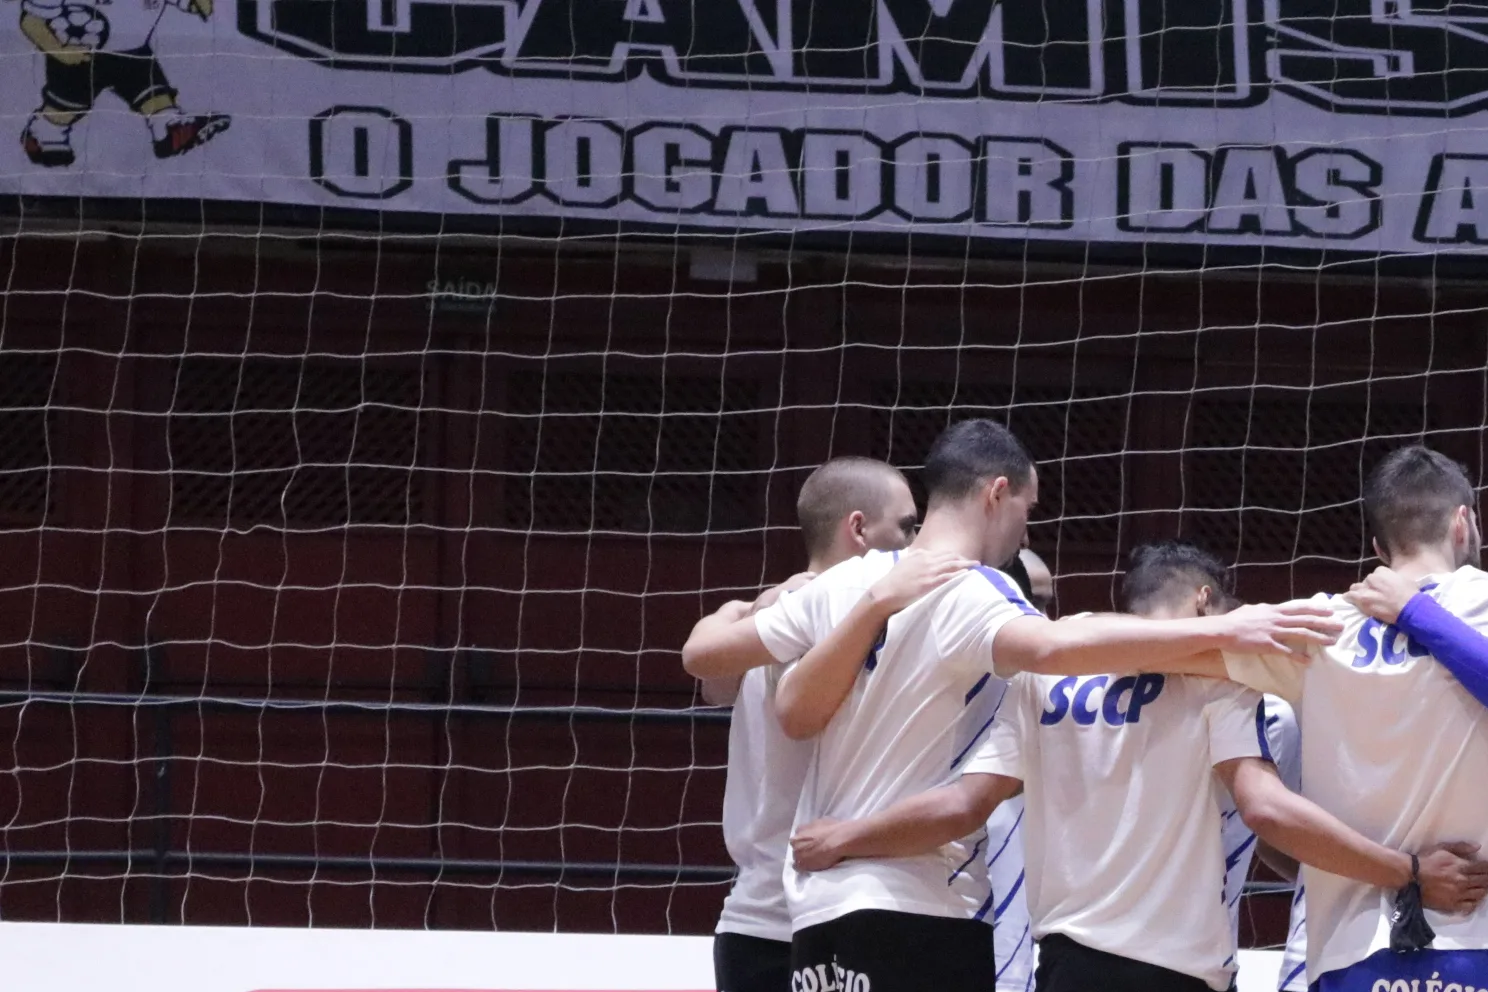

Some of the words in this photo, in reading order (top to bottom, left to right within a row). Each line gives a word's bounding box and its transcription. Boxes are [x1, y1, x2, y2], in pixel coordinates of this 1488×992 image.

[309, 105, 413, 200] O
[447, 112, 1076, 230] JOGADOR
[1117, 142, 1383, 241] DAS
[1040, 672, 1166, 726] SCCP
